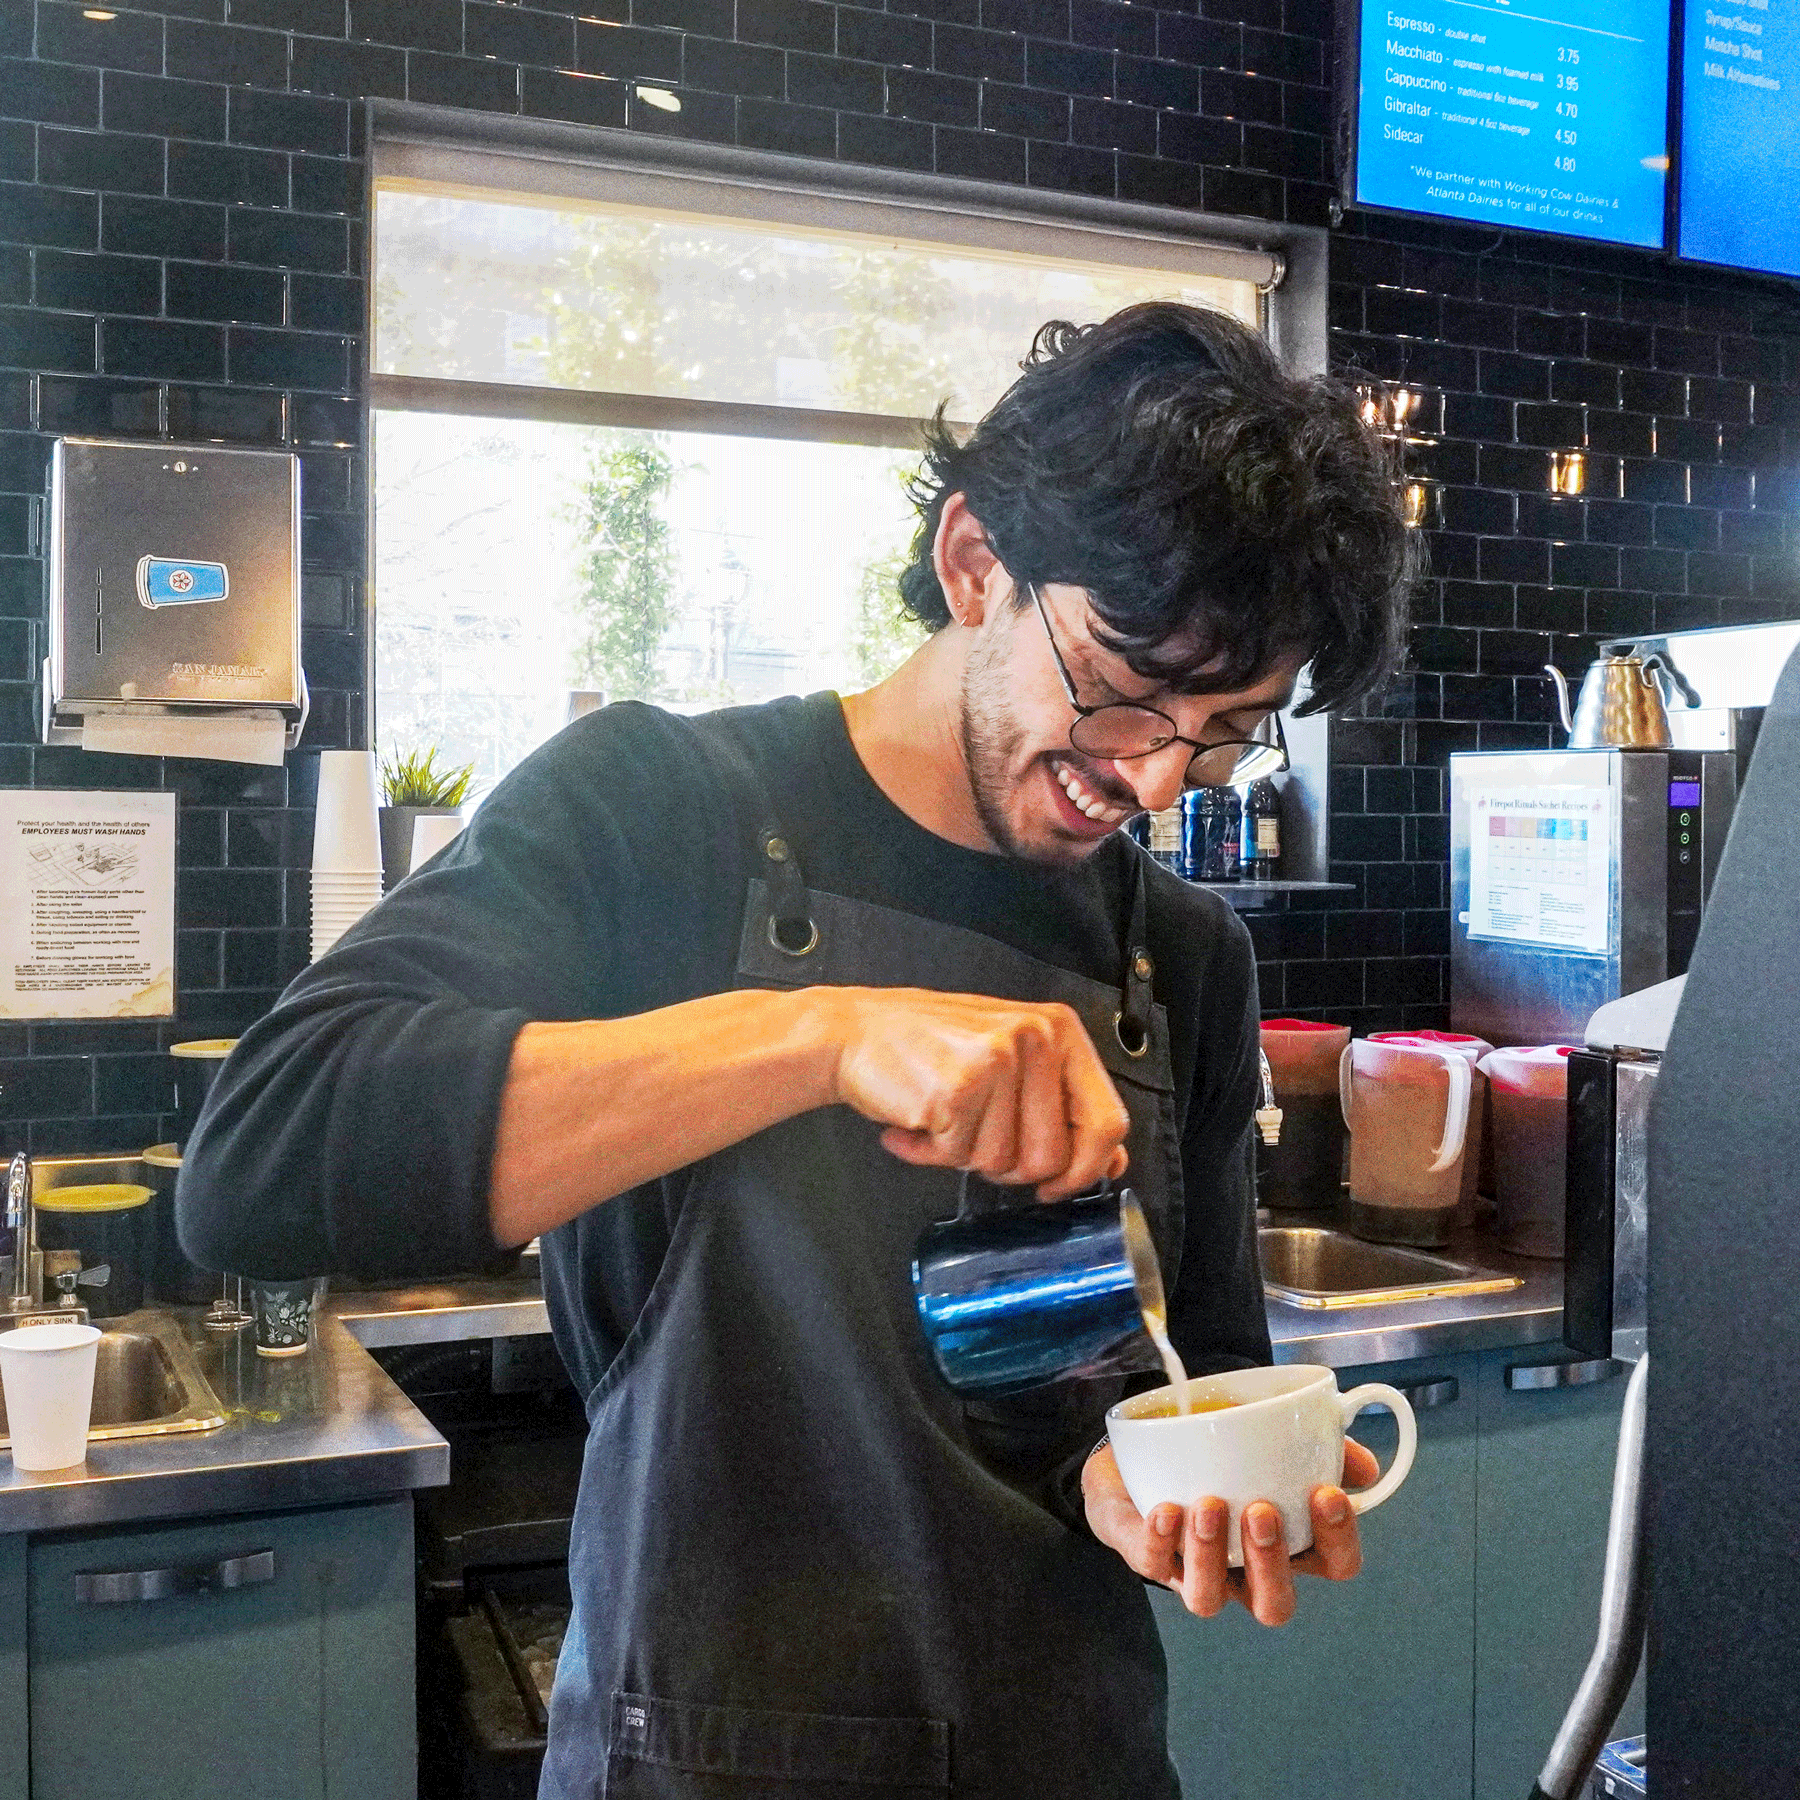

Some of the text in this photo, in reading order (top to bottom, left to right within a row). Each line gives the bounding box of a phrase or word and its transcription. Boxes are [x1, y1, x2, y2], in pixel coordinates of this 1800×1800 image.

[1388, 11, 1435, 34] Espresso
[1445, 28, 1469, 40] double
[1471, 33, 1487, 44] shot
[1558, 46, 1579, 64] 3.75
[1386, 39, 1443, 63] Macchiato
[1453, 59, 1485, 72] espresso
[1486, 65, 1501, 74] with
[1556, 73, 1579, 91] 3.95
[1385, 67, 1447, 92] Cappuccino
[1457, 87, 1493, 101] traditional
[1507, 95, 1540, 111] beverage
[1556, 102, 1578, 118] 4.70
[1384, 95, 1432, 117] Gibraltar
[1442, 111, 1478, 125] traditional
[1498, 121, 1531, 137] beverage
[1555, 128, 1577, 145] 4.50
[1384, 124, 1576, 172] Sidecar 4.80
[1426, 186, 1604, 224] Atlanta Dairies for all of our drinks
[1436, 170, 1475, 185] partner
[1478, 177, 1501, 189] with
[1504, 181, 1548, 199] Working
[1550, 188, 1573, 201] Cow
[1575, 192, 1609, 208] Dairies
[53, 1317, 73, 1325] SINK
[626, 1716, 645, 1727] CREW
